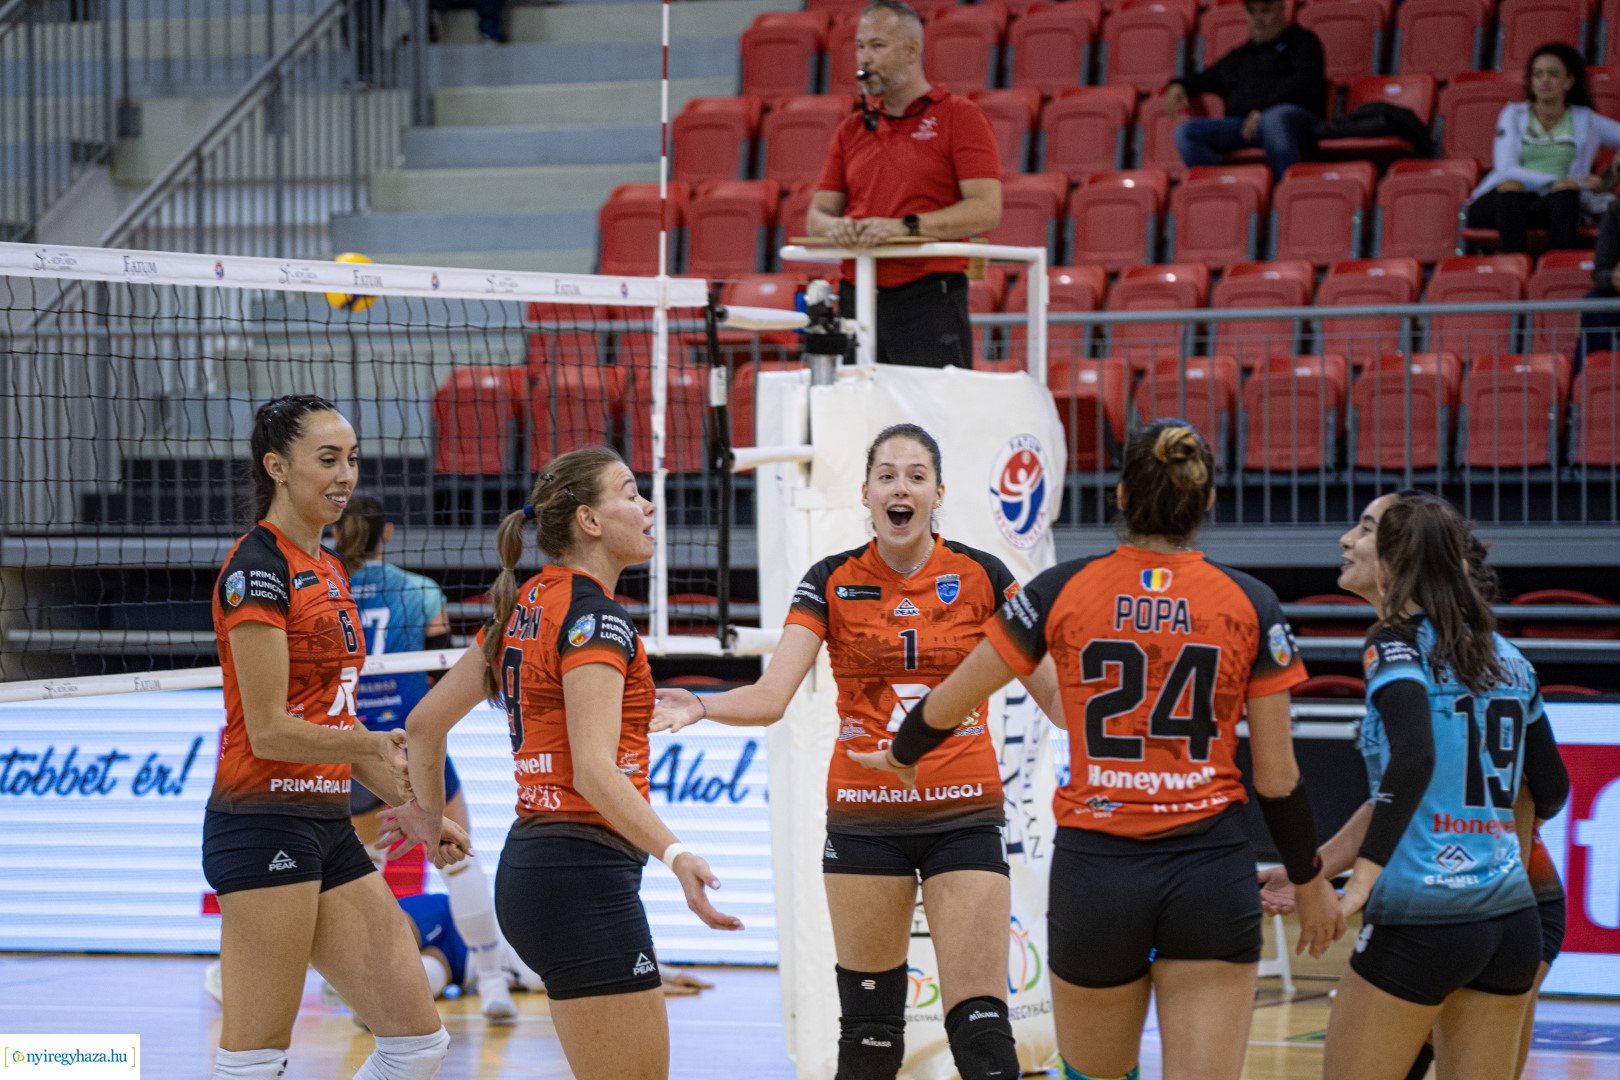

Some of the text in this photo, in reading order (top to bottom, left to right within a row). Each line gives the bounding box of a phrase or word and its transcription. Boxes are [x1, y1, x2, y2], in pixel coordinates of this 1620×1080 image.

[250, 590, 278, 600] LUGOJ
[1114, 595, 1192, 635] POPA
[336, 609, 358, 653] 6
[600, 631, 627, 646] LUGOJ
[898, 628, 918, 671] 1
[1080, 637, 1221, 762] 24
[131, 735, 203, 796] ér!
[1453, 693, 1527, 811] 19
[270, 775, 340, 794] PRIMĂRIA
[836, 783, 984, 803] PRIMĂRIA LUGOJ
[268, 860, 298, 872] PEAK
[632, 962, 657, 976] PEAK
